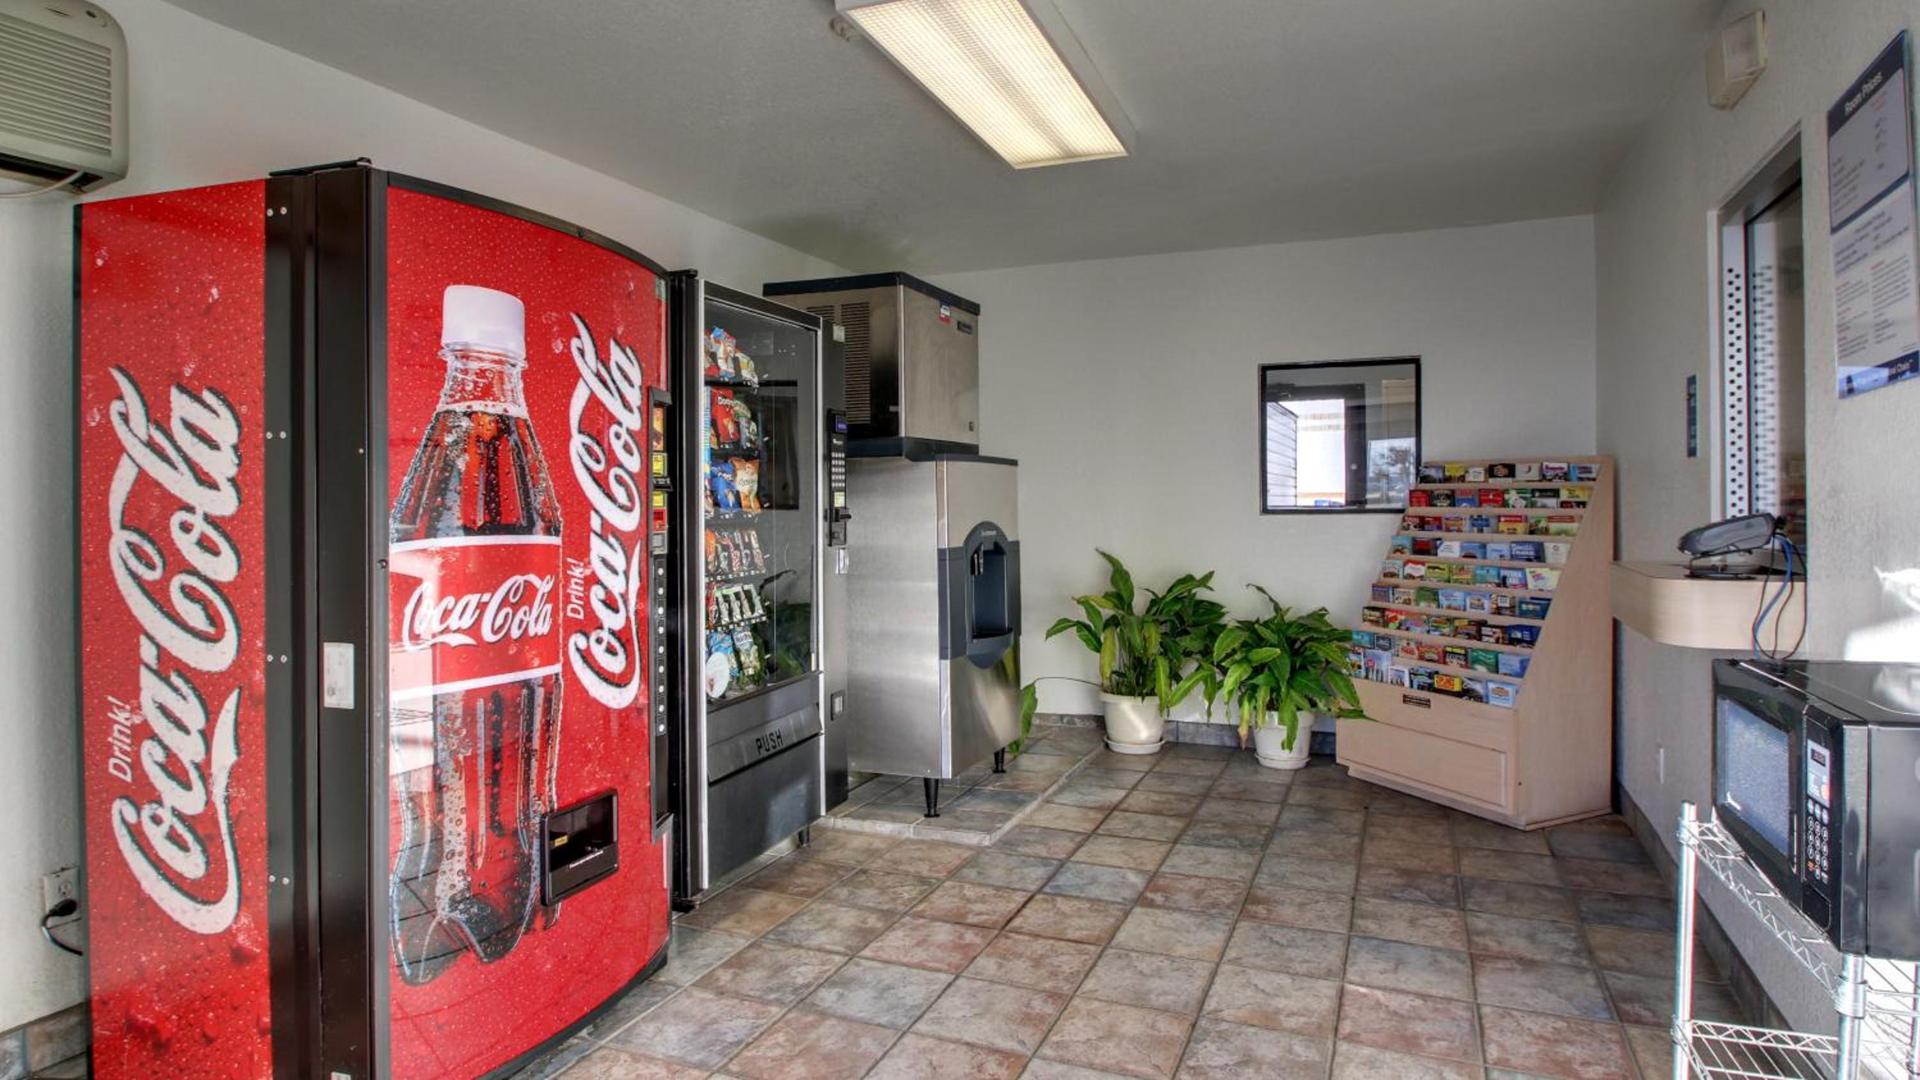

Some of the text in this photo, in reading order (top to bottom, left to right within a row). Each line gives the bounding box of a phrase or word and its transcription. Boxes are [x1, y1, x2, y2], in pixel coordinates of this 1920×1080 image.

[569, 313, 643, 710] Coca-Cola
[402, 573, 555, 652] Coca-Cola
[567, 557, 586, 621] Drink!
[108, 366, 243, 935] Coca-Cola
[108, 695, 132, 782] Drink!
[755, 728, 784, 756] PUSH
